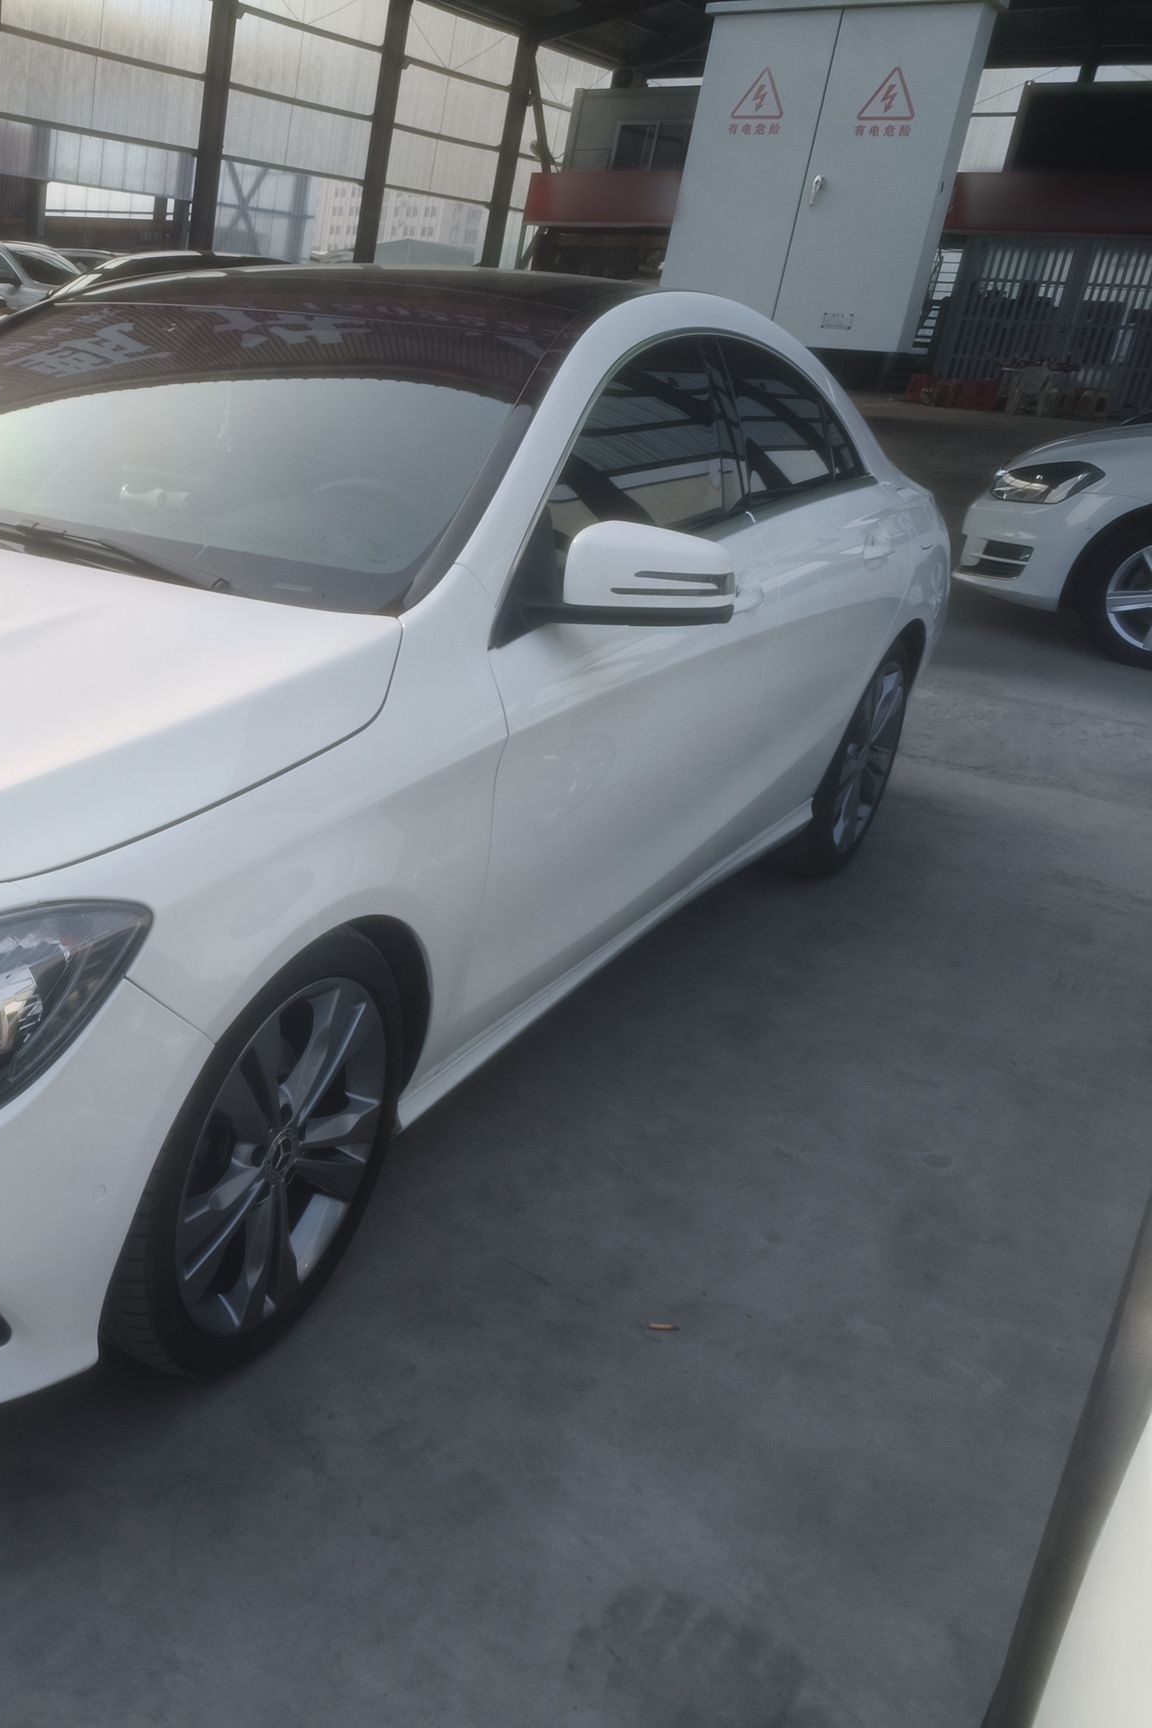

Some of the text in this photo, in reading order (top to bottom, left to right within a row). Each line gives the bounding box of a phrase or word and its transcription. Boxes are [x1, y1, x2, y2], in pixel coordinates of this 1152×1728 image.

[728, 122, 781, 136] 有电危险
[854, 124, 912, 137] 有电危险
